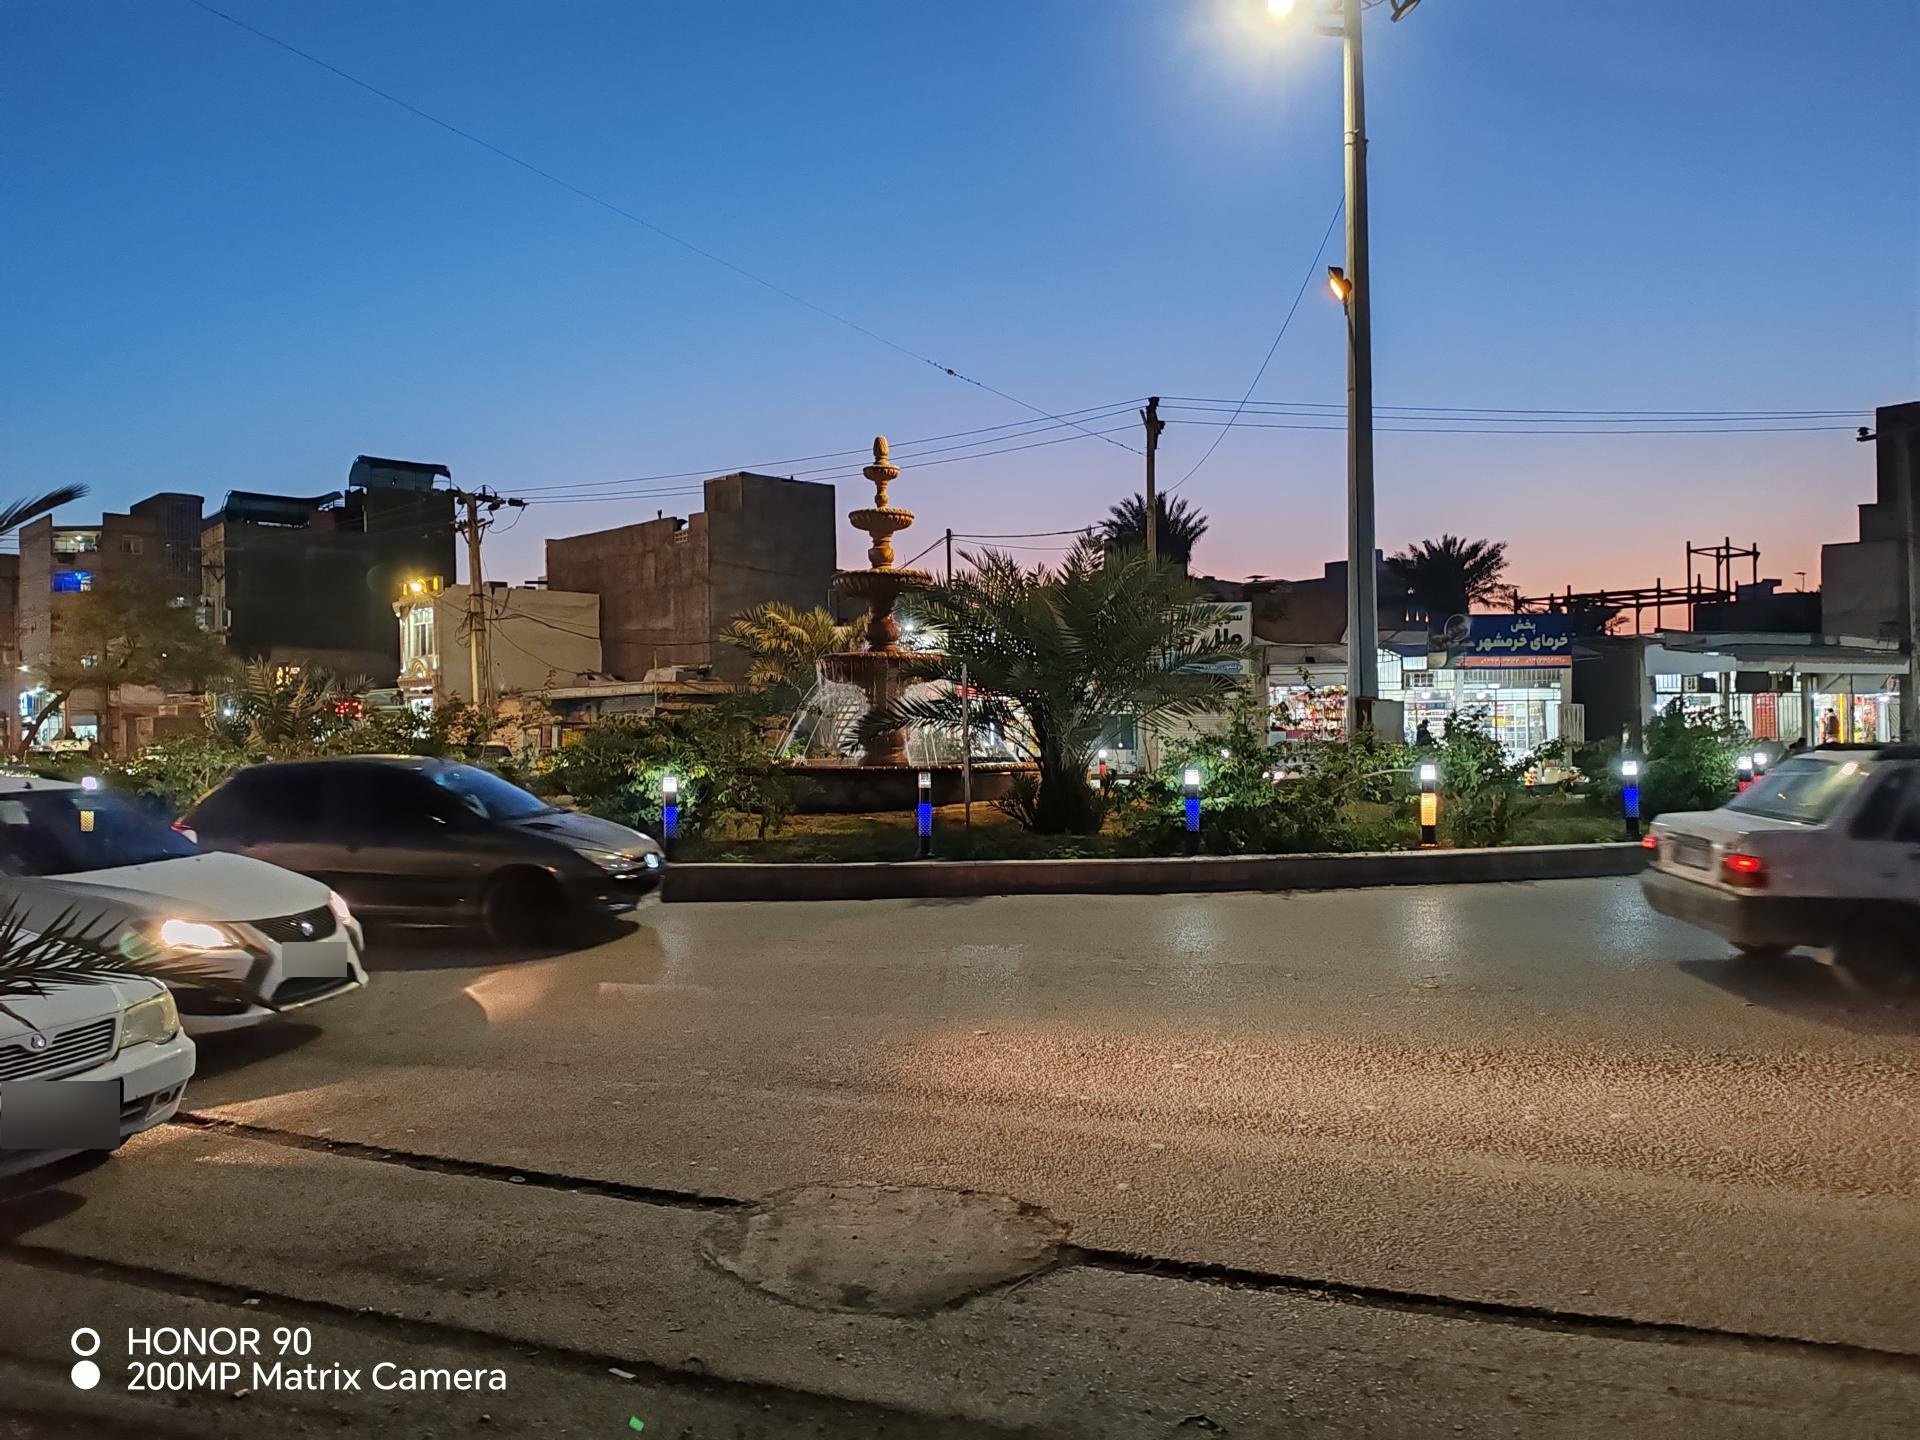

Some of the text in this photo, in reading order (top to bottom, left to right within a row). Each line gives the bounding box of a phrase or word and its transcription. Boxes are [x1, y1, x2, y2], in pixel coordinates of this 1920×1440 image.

[1510, 618, 1536, 634] پخش
[1475, 632, 1568, 652] خرمای خرمشهر
